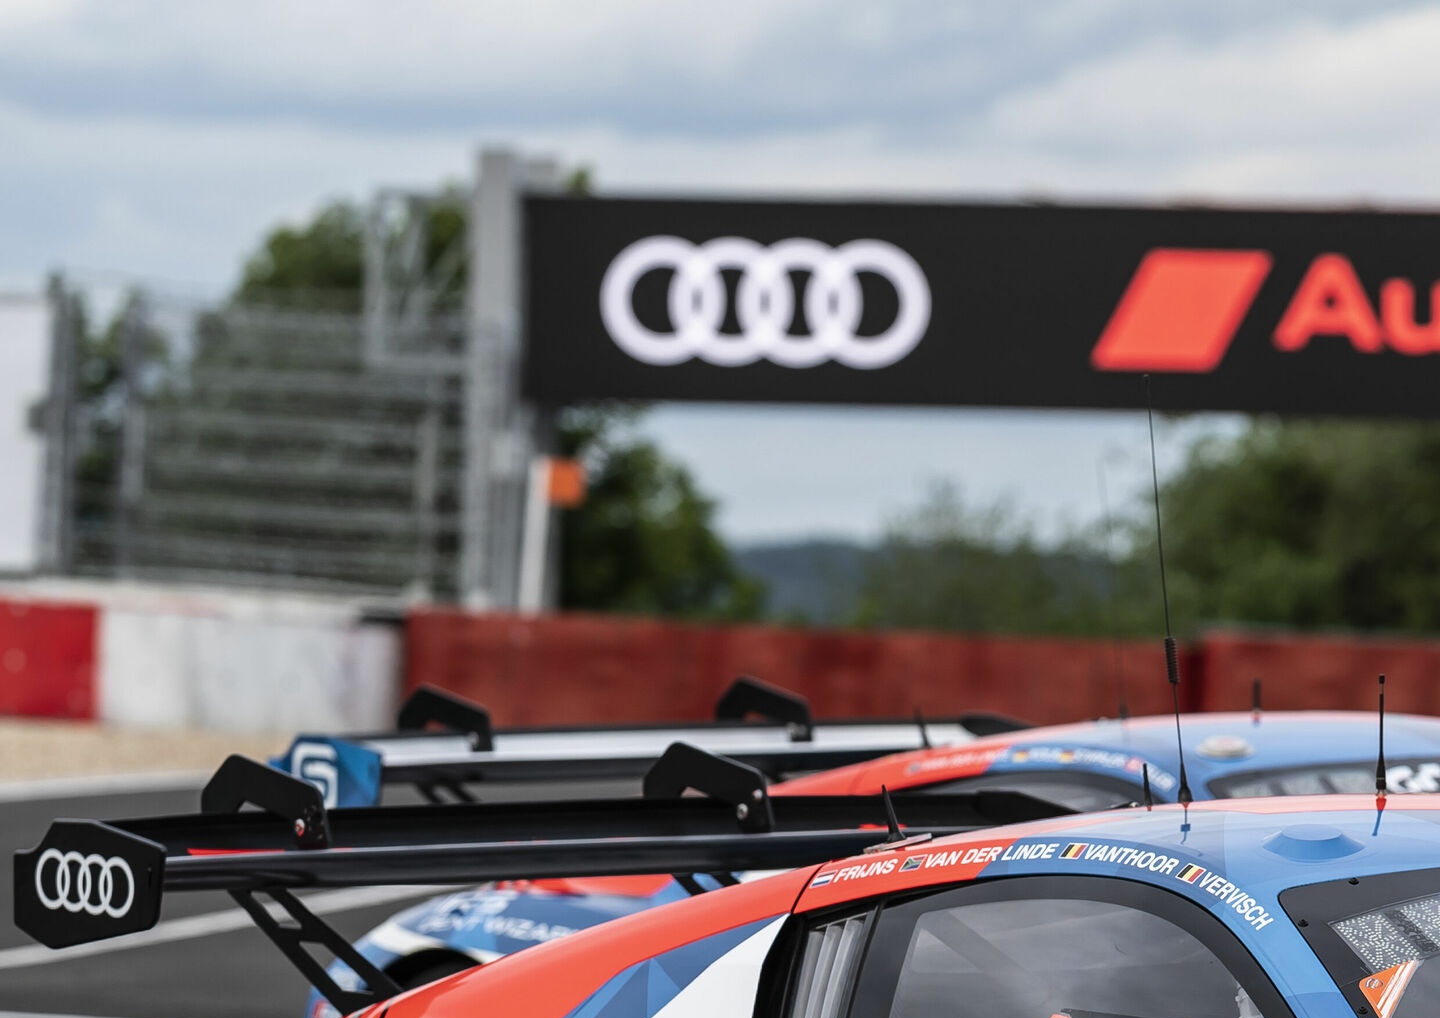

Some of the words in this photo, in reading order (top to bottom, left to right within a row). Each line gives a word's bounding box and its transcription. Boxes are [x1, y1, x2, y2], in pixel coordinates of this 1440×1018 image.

[832, 858, 898, 884] FRIJNS
[923, 850, 960, 870] VAN
[961, 845, 1003, 864] DER
[1001, 842, 1060, 862] LINDE
[1083, 843, 1180, 876] VANTHOOR
[1197, 871, 1276, 932] VERVISCH
